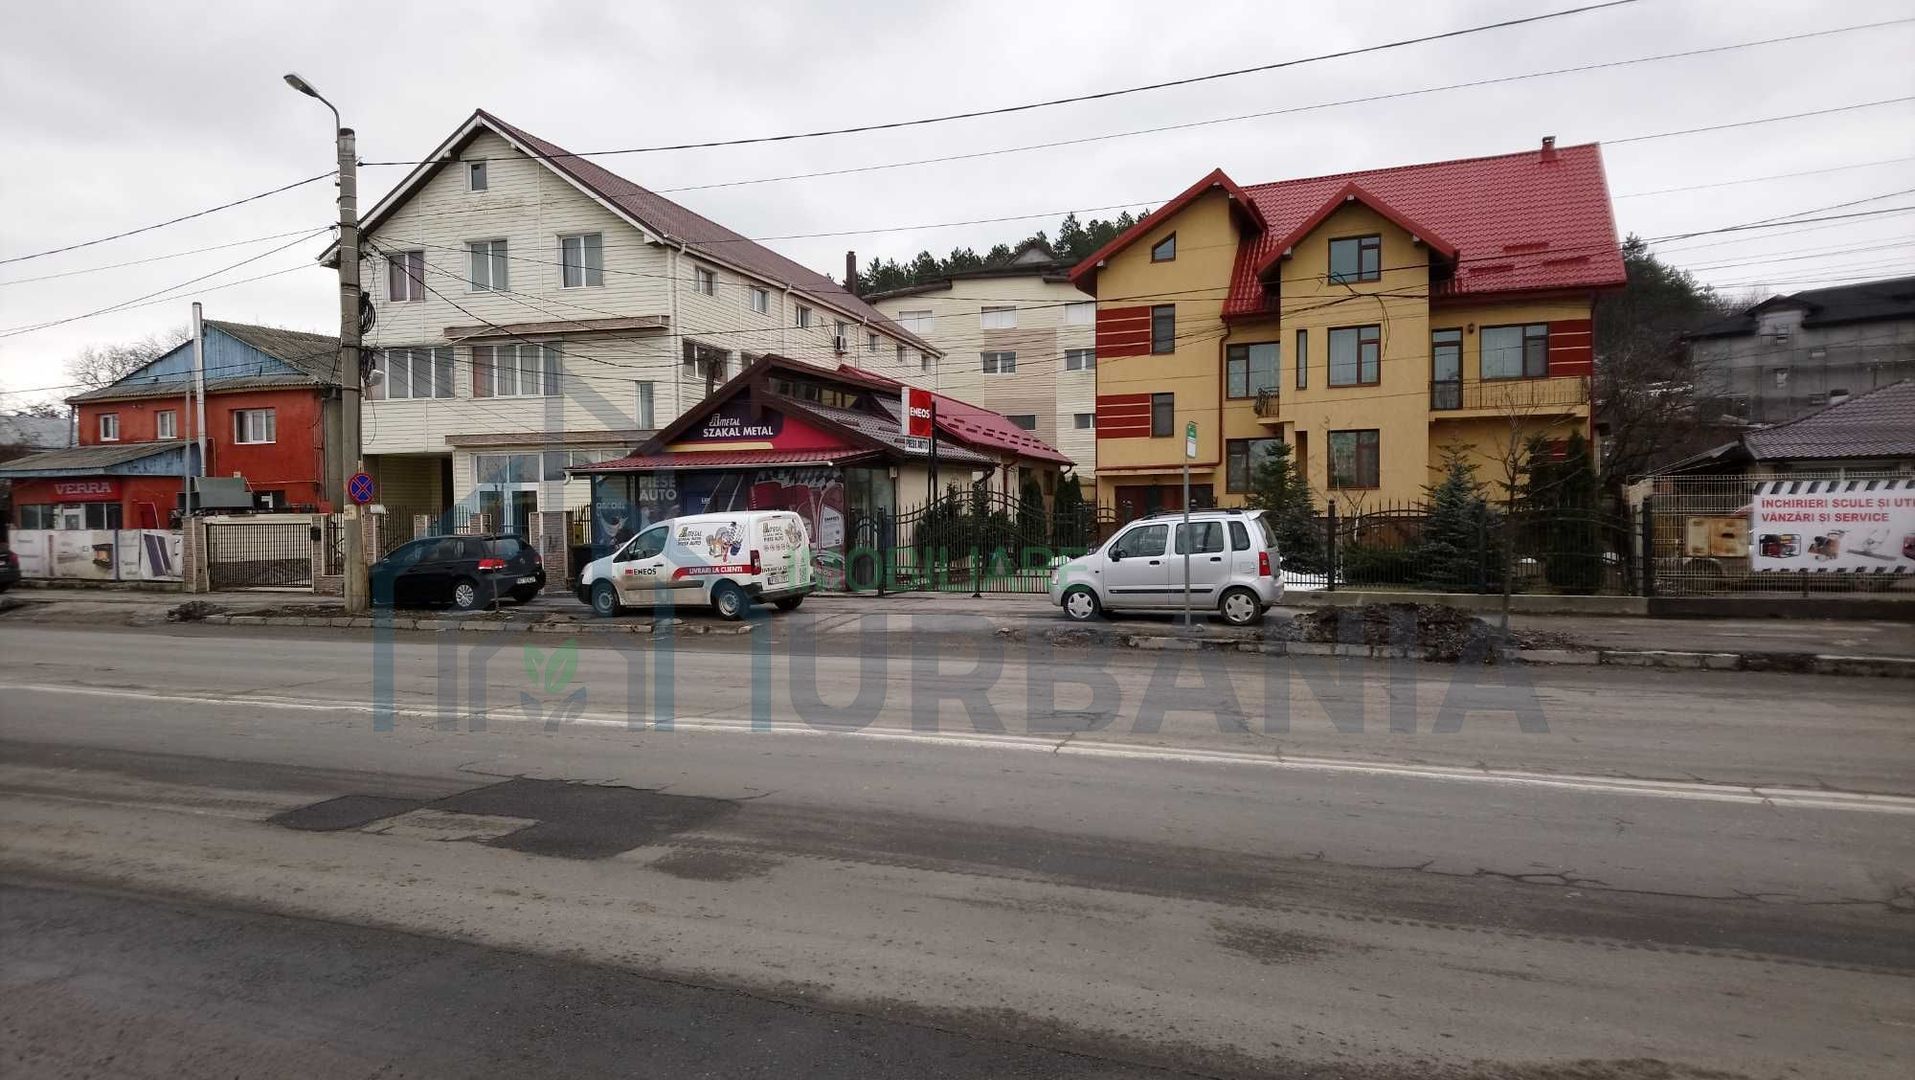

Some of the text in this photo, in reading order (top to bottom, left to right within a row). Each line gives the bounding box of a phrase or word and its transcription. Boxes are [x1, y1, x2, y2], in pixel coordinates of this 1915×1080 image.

[909, 406, 930, 419] ENEOS
[703, 426, 774, 438] SZAKAL METAL
[639, 475, 676, 488] PIESE
[54, 482, 113, 495] VERRA
[638, 488, 677, 501] AUTO
[1761, 497, 1828, 509] ÎNCHIRIERI
[1831, 498, 1874, 509] SCULE
[1834, 512, 1889, 522] SERVICE
[633, 568, 657, 576] ENEOS
